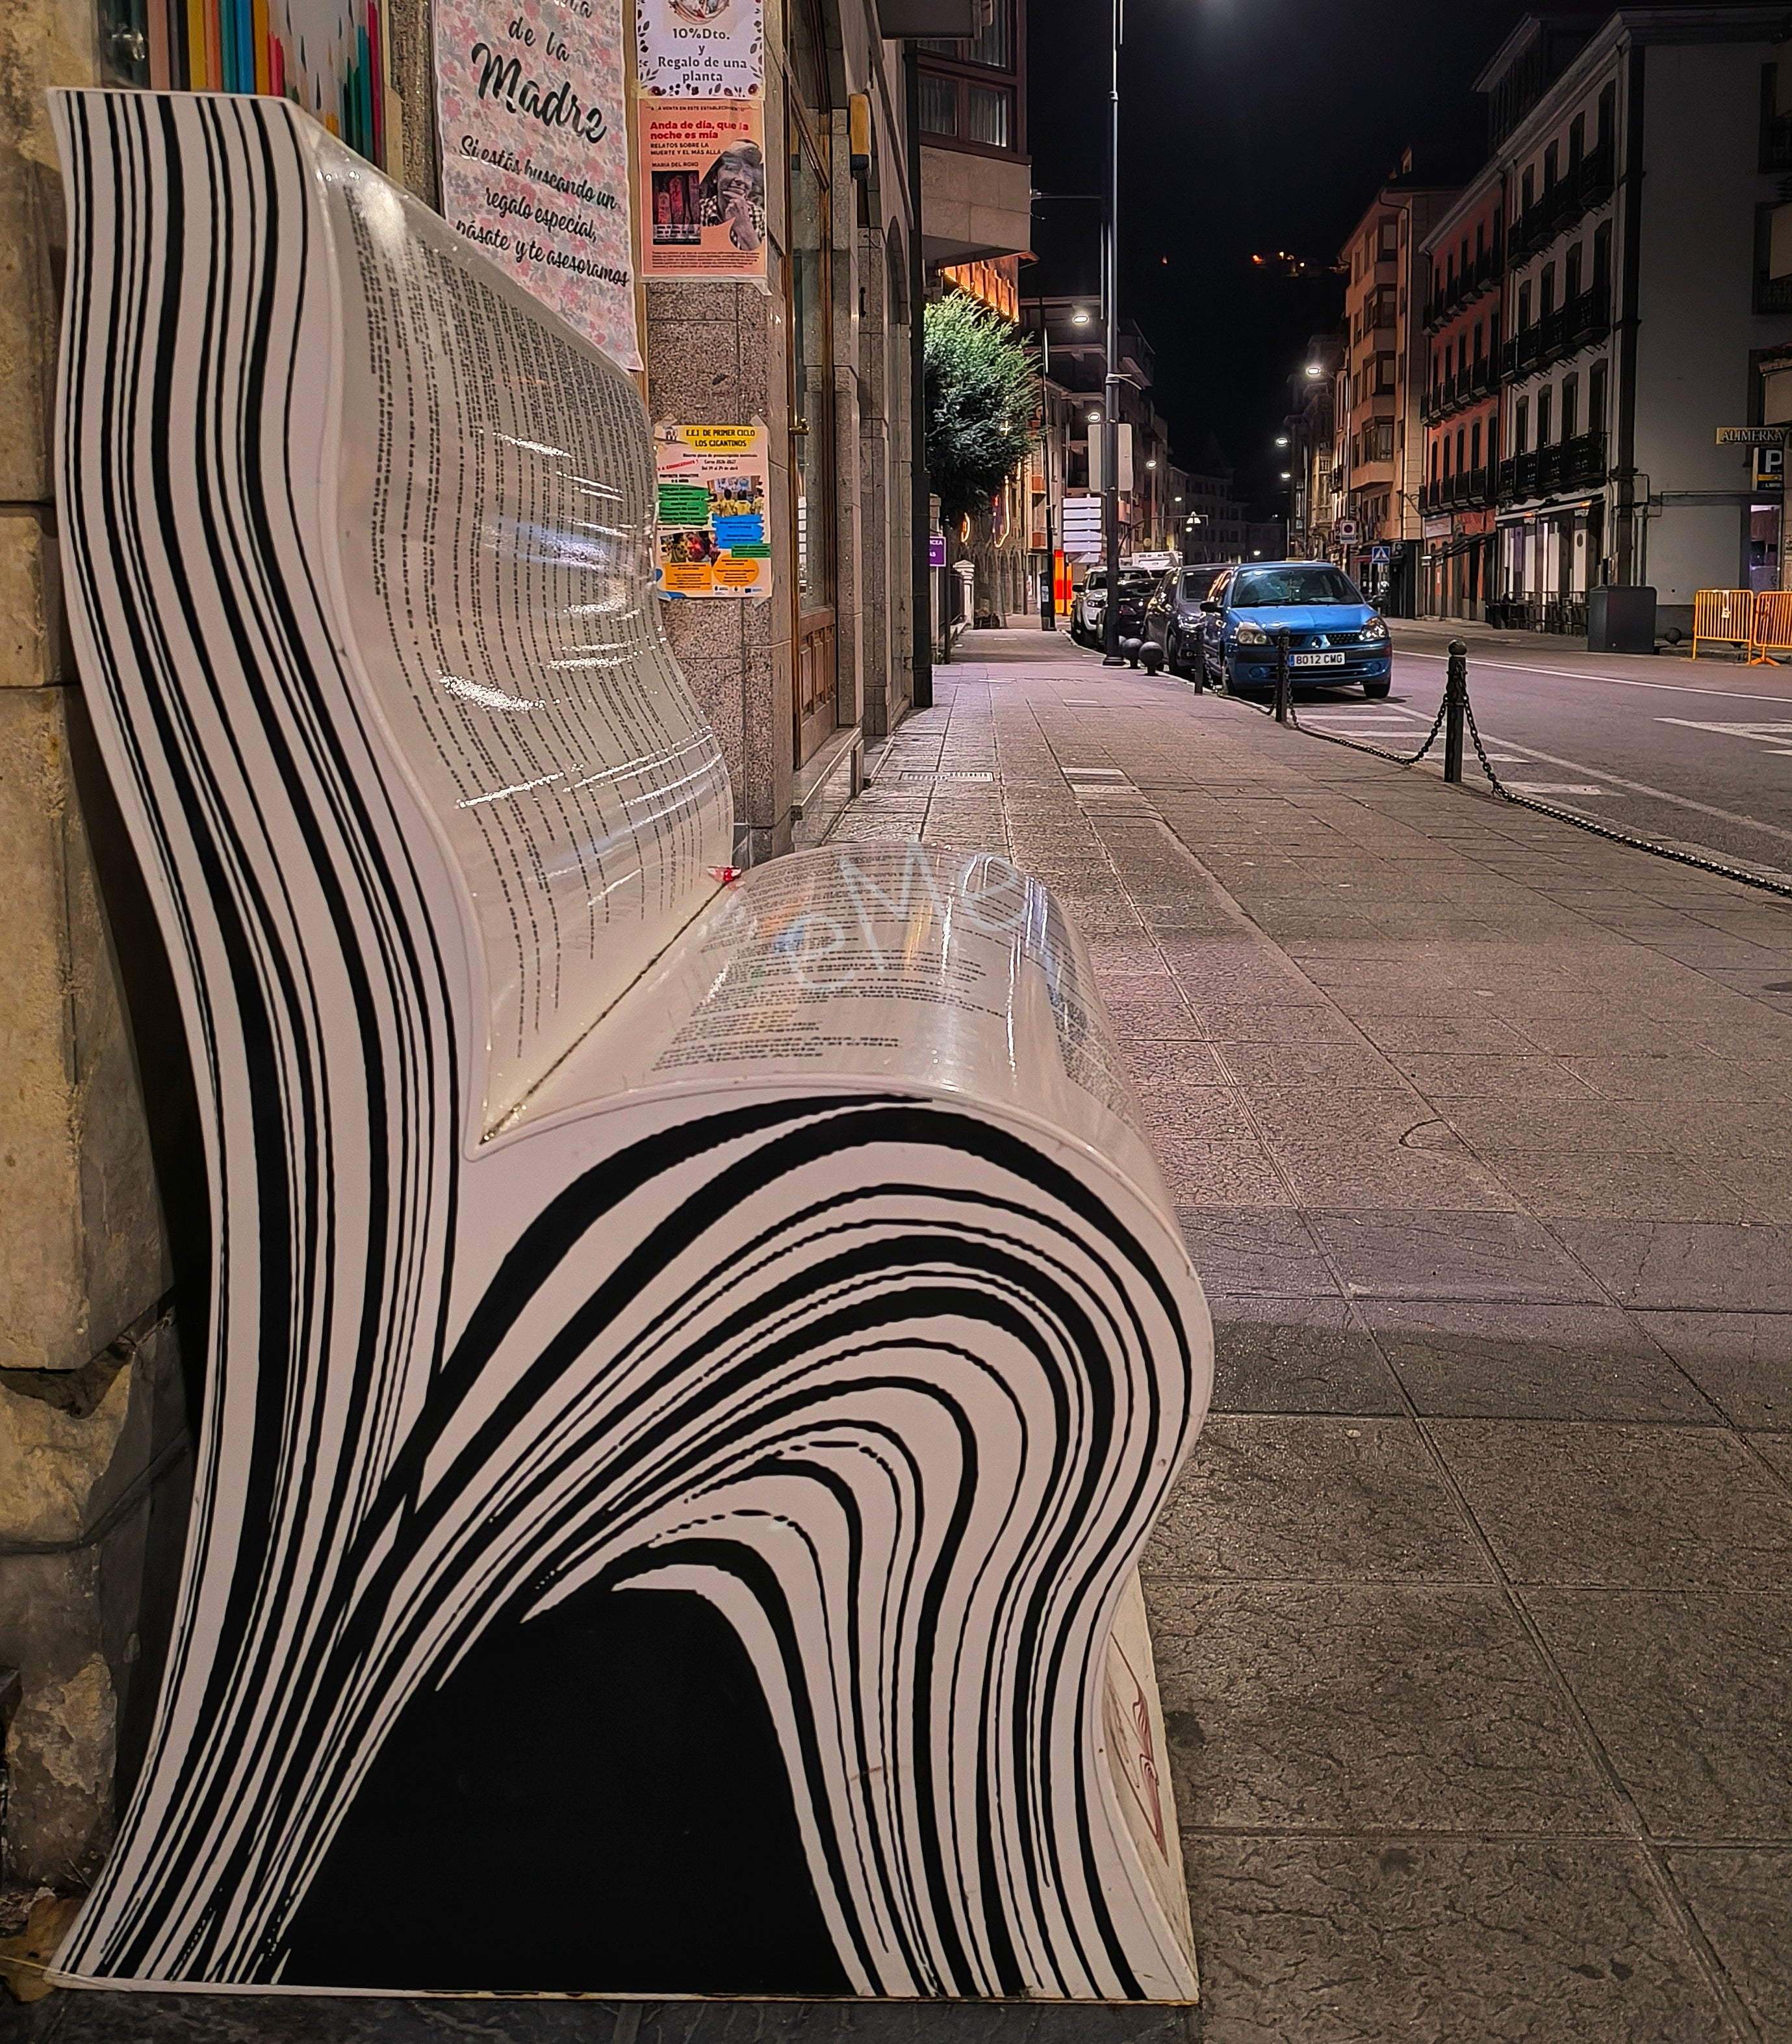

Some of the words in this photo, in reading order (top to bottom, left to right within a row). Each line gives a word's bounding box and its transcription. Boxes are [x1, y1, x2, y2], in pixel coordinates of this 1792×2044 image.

[508, 17, 536, 47] de
[546, 31, 570, 62] la
[698, 45, 705, 55] y
[658, 56, 700, 70] Regalo
[704, 57, 719, 67] de
[723, 60, 747, 68] una
[682, 70, 723, 84] planta
[471, 42, 607, 144] Madre
[650, 121, 678, 130] Anda
[680, 121, 693, 129] de
[696, 120, 715, 130] día,
[717, 122, 736, 131] que
[650, 131, 682, 139] noche
[699, 131, 718, 139] mía
[459, 135, 480, 157] Si
[481, 148, 522, 175] estás
[524, 159, 596, 202] buscando
[596, 191, 618, 209] un
[486, 187, 533, 218] regalo
[535, 208, 596, 243] especial,
[515, 240, 528, 262] y
[528, 242, 545, 262] te
[546, 250, 630, 287] asesoramos
[1721, 429, 1783, 442] ALIMERKA
[1765, 450, 1782, 472] P
[1296, 655, 1321, 664] 8012
